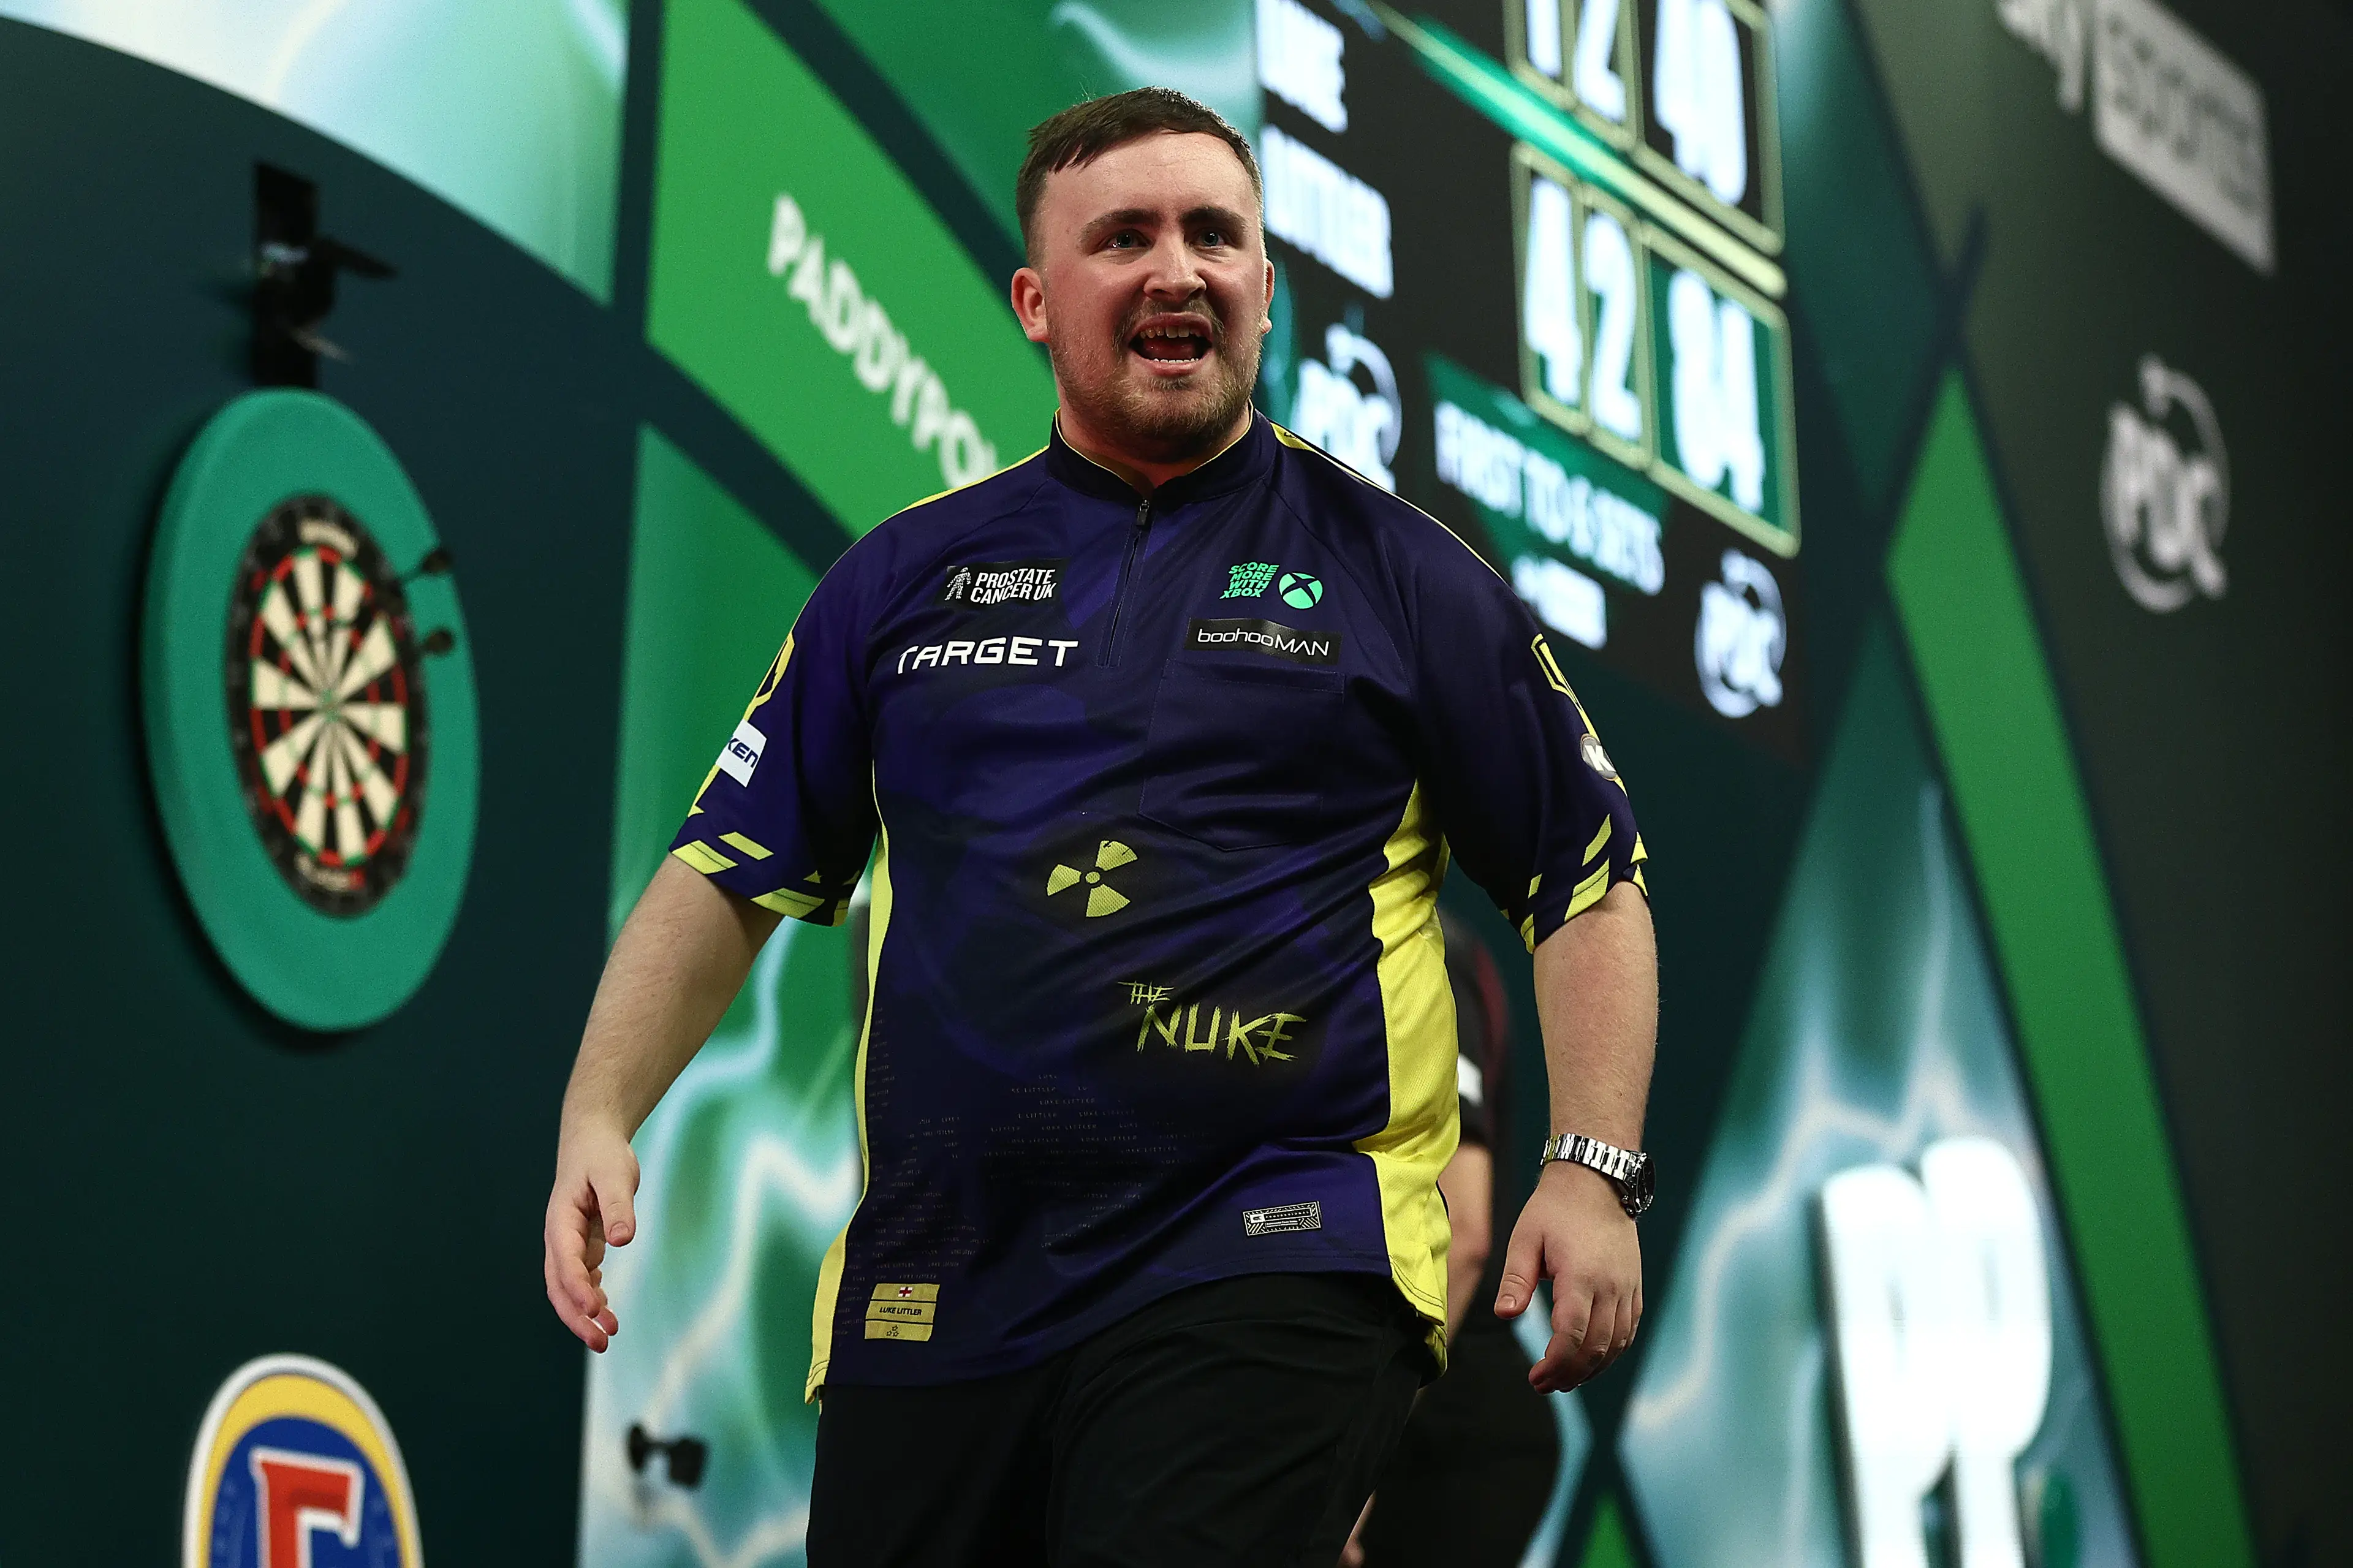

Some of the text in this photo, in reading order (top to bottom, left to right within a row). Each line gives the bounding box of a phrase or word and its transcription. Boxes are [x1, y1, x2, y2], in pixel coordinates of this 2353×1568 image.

[767, 193, 998, 488] PADDYPO
[975, 568, 1056, 588] PROSTATE
[1228, 562, 1280, 574] SCORE
[1229, 571, 1275, 582] MORE
[969, 582, 1057, 605] CANCER UK
[1219, 588, 1265, 599] XBOX
[1229, 578, 1271, 591] WITH
[1197, 627, 1330, 656] boohooMAN
[897, 635, 1079, 675] TARGET
[1117, 980, 1175, 1005] THE
[1136, 1002, 1307, 1068] NUKE
[896, 1307, 923, 1316] LITTLER
